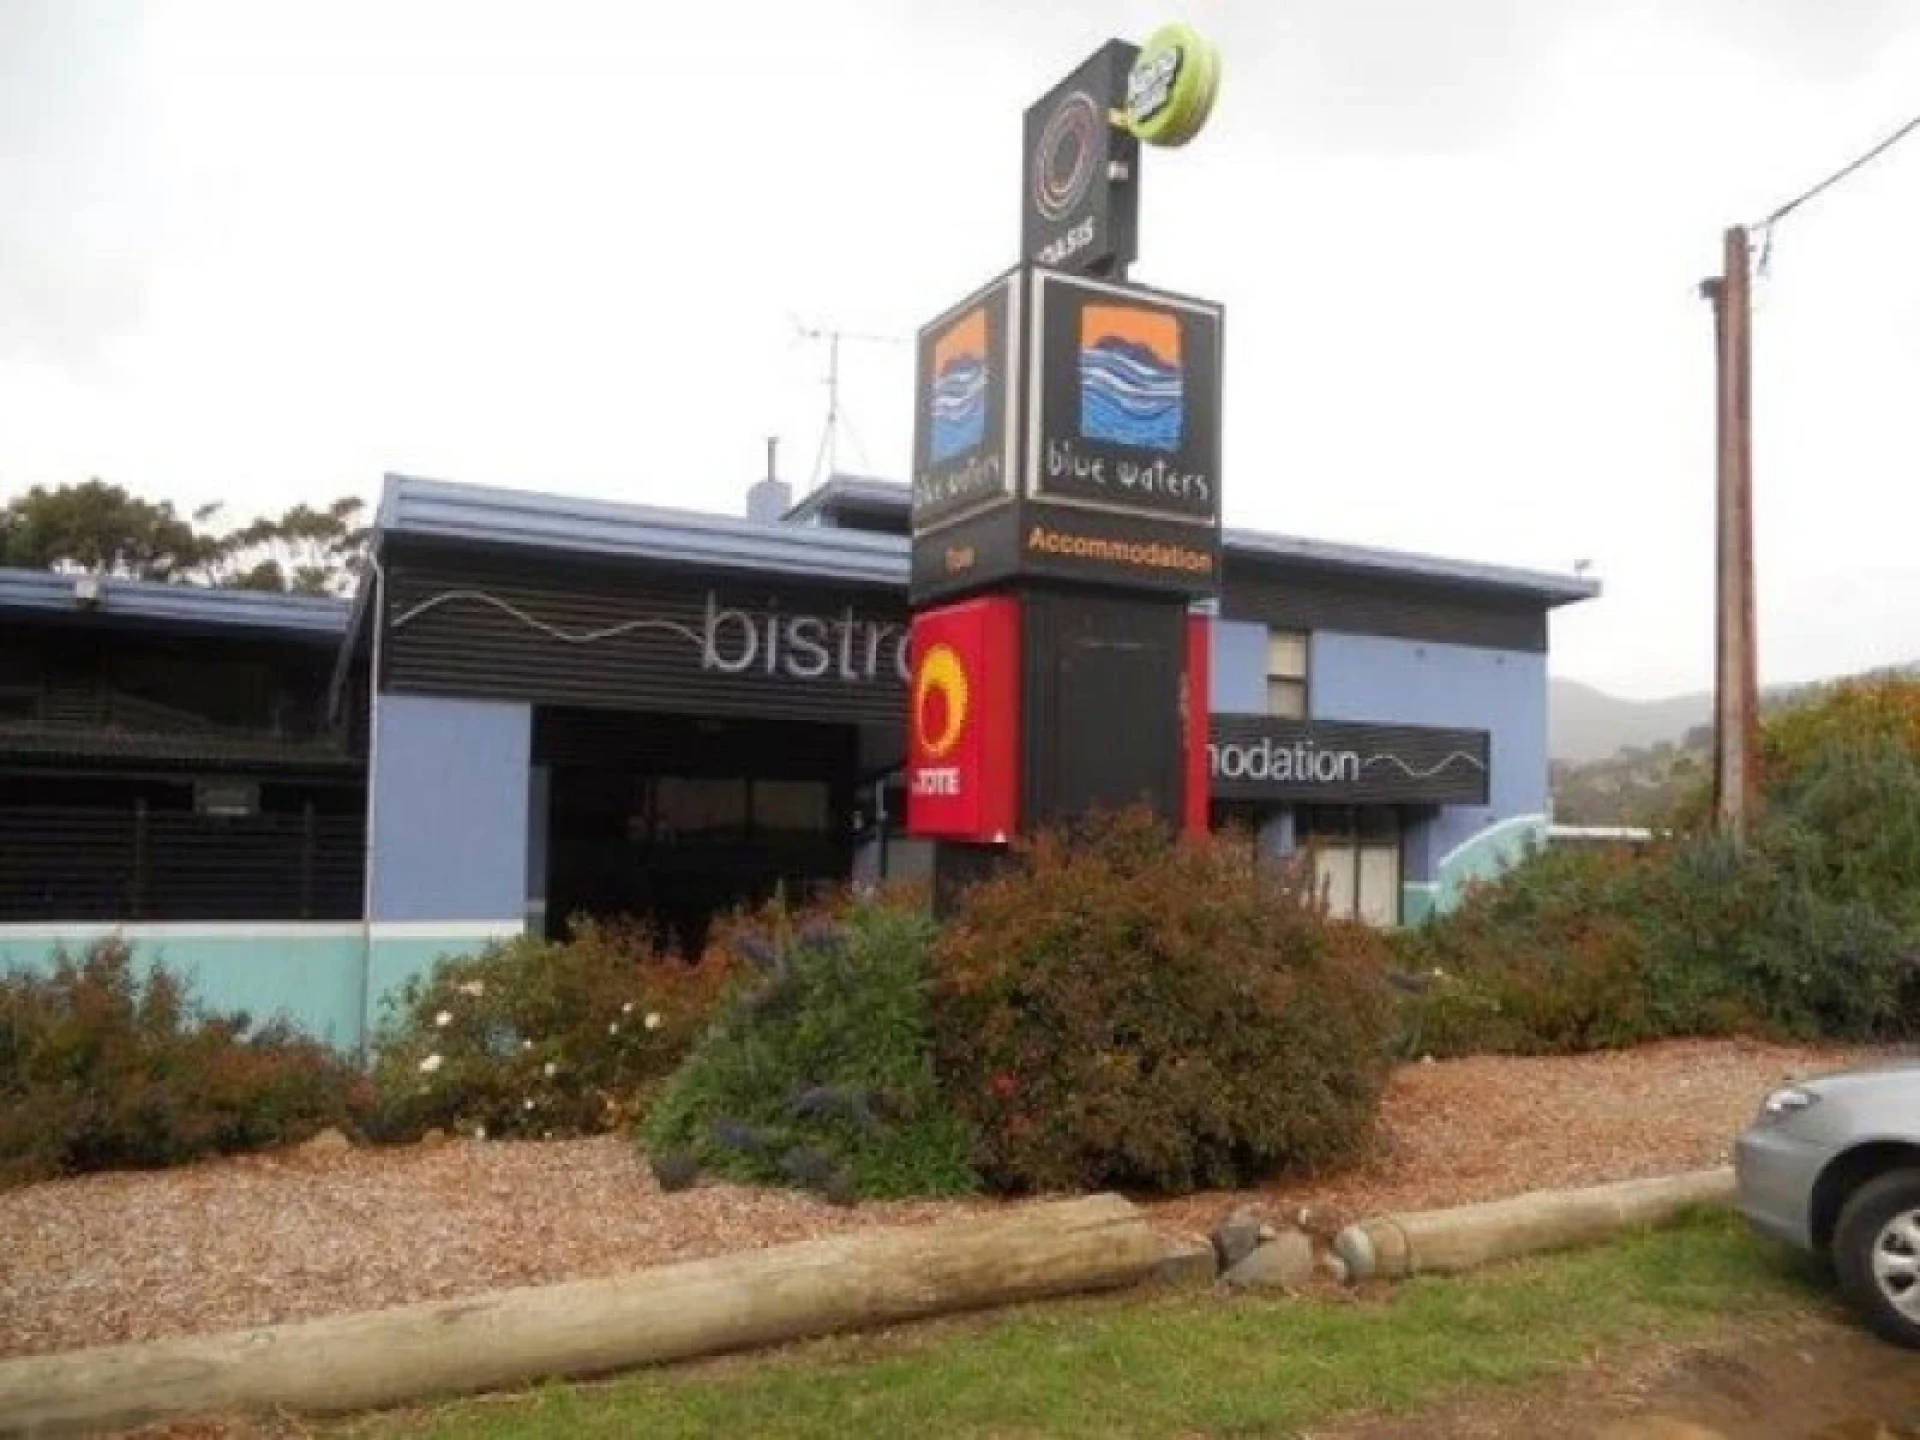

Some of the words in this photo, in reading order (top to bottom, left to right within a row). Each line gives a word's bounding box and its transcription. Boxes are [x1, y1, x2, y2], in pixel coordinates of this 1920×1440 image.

[1050, 439, 1106, 484] blue
[1116, 459, 1209, 499] waters
[1028, 526, 1213, 572] Accommodation
